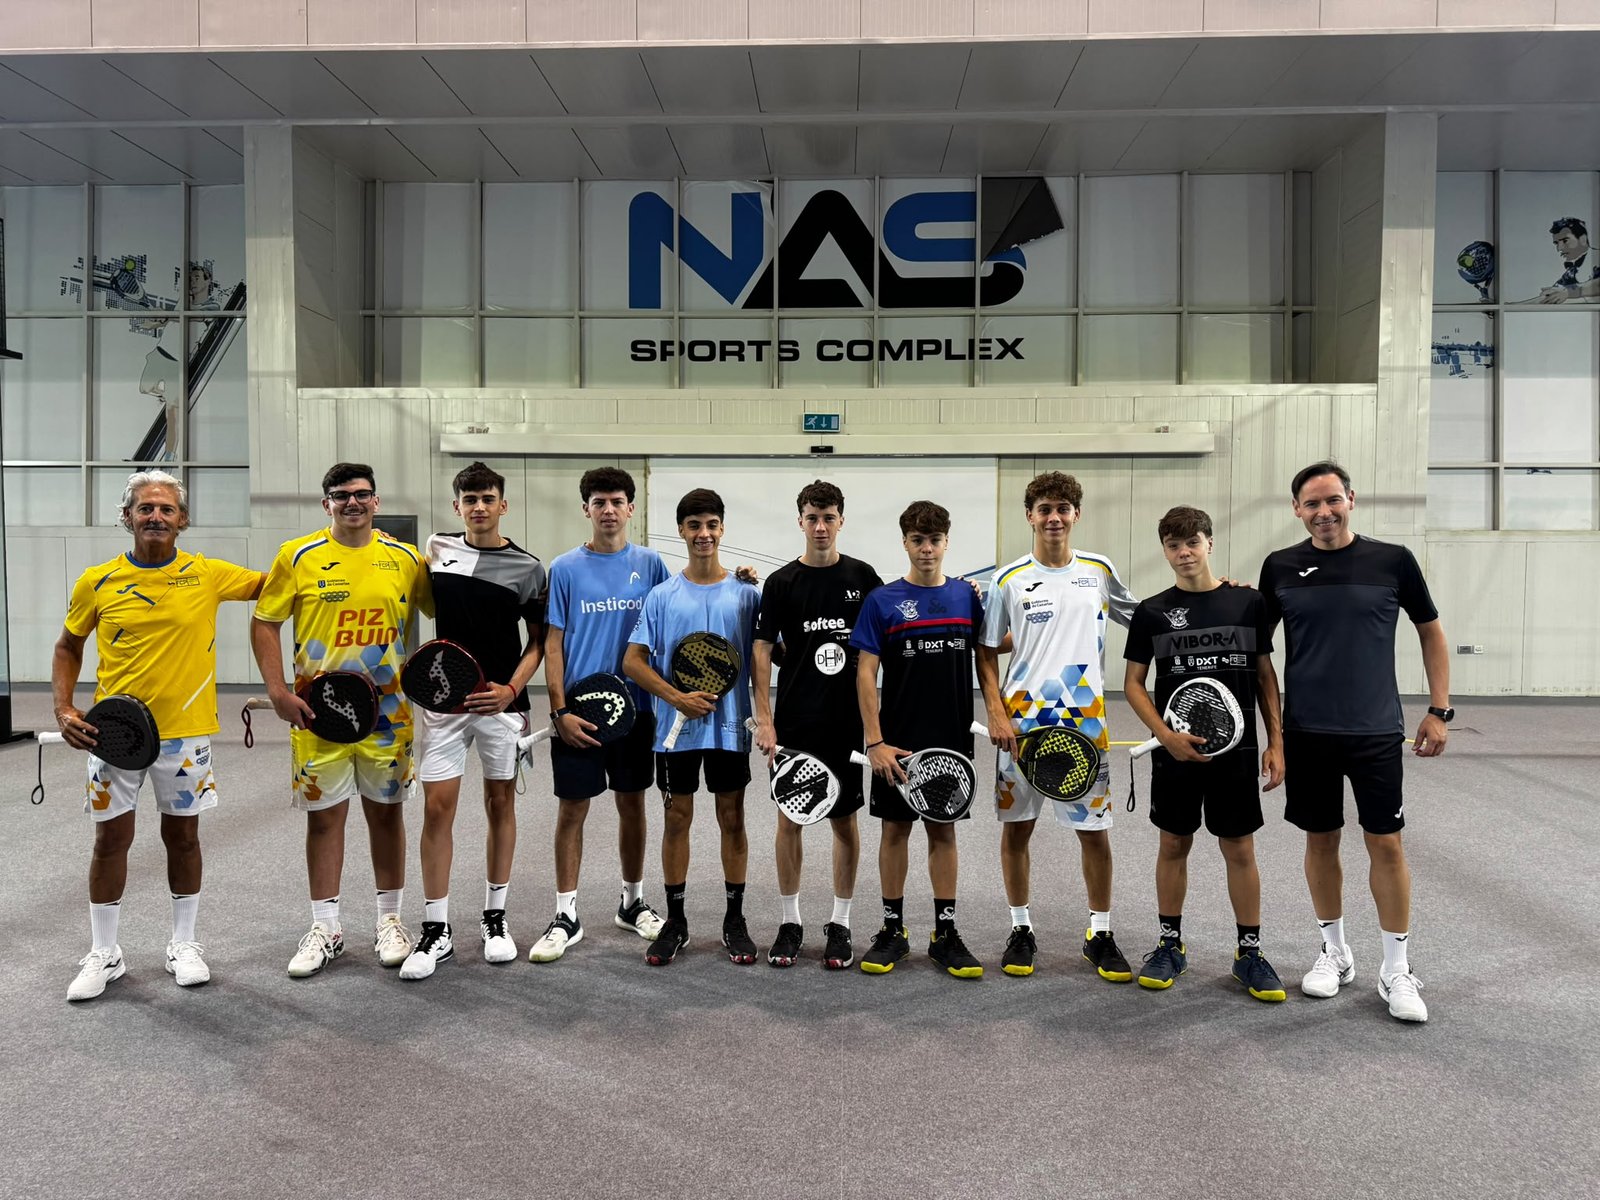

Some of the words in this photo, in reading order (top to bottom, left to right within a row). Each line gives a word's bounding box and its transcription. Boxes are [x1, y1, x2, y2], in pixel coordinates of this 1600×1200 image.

[629, 189, 1027, 309] NAS
[630, 339, 800, 362] SPORTS
[816, 337, 1026, 361] COMPLEX
[338, 608, 384, 627] PIZ
[334, 626, 398, 647] BUIN
[925, 640, 944, 649] DXT
[1196, 656, 1218, 666] DXT
